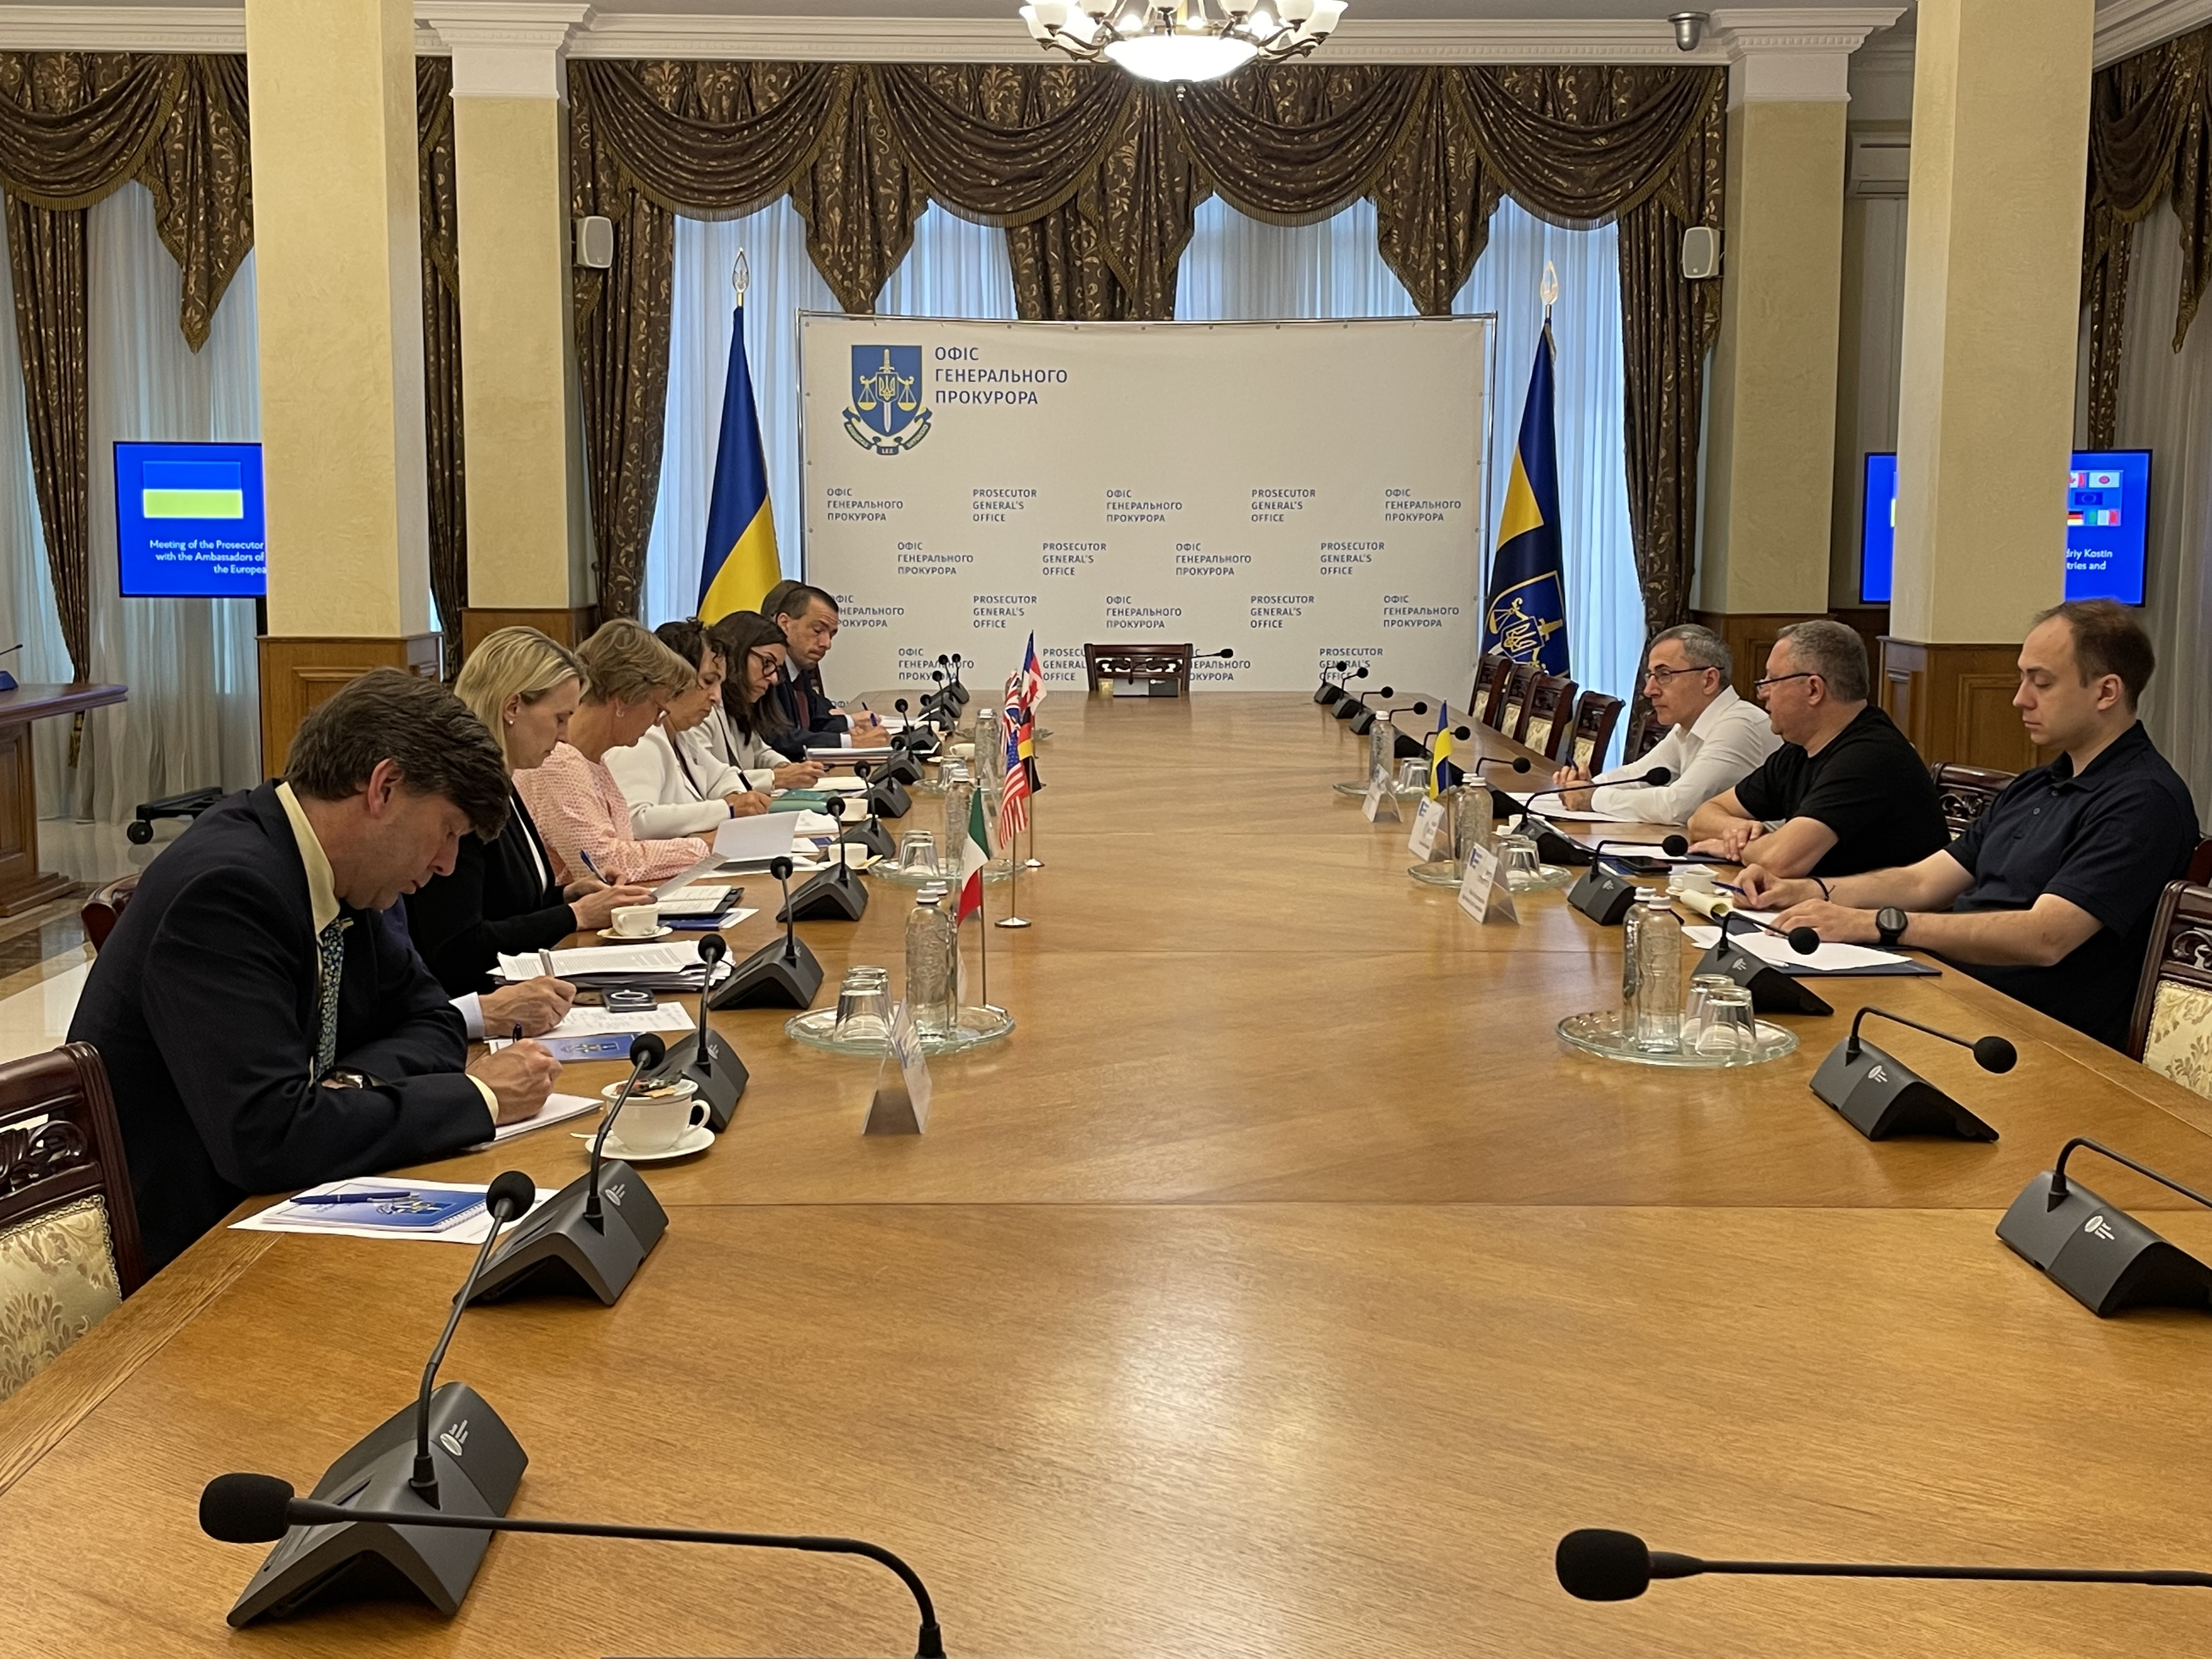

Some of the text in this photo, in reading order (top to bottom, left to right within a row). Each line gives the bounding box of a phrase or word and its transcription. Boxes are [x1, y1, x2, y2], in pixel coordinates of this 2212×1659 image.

[935, 347, 979, 360] ОФІС
[936, 369, 1067, 383] ГЕНЕРАЛЬНОГО
[936, 391, 1038, 404] ПРОКУРОРА
[827, 488, 852, 496] ОФІС
[973, 489, 1037, 498] PROSECUTOR
[1252, 489, 1316, 498] PROSECUTOR
[1385, 489, 1410, 497] ОФІС
[827, 500, 903, 509] ГЕНЕРАЛЬНОГО
[973, 501, 1024, 510] GENERAL'S
[1251, 501, 1302, 510] GENERAL'S
[1386, 501, 1461, 509] ГЕНЕРАЛЬНОГО
[828, 513, 886, 521] ПРОКУРОРА
[973, 514, 1005, 522] OFFICE
[1107, 514, 1165, 522] ПРОКУРОРА
[1385, 513, 1444, 521] ПРОКУРОРА
[150, 539, 263, 551] Meeting of the Prosecutor
[898, 542, 922, 550] ОФІС
[1043, 543, 1106, 551] PROSECUTOR
[1321, 542, 1384, 550] PROSECUTOR
[156, 551, 264, 561] with the Ambassadors of
[2084, 549, 2113, 557] Kostin
[898, 554, 973, 562] ГЕНЕРАЛЬНОГО
[1043, 555, 1094, 563] GENERAL'S
[1176, 555, 1251, 563] ГЕНЕРАЛЬНОГО
[1321, 554, 1372, 562] GENERAL'S
[213, 564, 267, 575] the Europea
[2067, 561, 2106, 570] tries and
[1043, 567, 1075, 575] OFFICE
[1176, 567, 1234, 575] ПРОКУРОРА
[1321, 567, 1353, 575] OFFICE
[1251, 596, 1314, 604] PROSECUTOR
[973, 607, 1024, 616] GENERAL'S
[1107, 608, 1182, 616] ГЕНЕРАЛЬНОГО
[1251, 607, 1301, 616] GENERAL'S
[1107, 620, 1165, 628] ПРОКУРОРА
[1043, 648, 1085, 657] PROSECU
[1043, 661, 1086, 669] GENERAL
[1194, 661, 1251, 669] ЕРАЛЬНОГО
[1043, 673, 1075, 681] OFFICE
